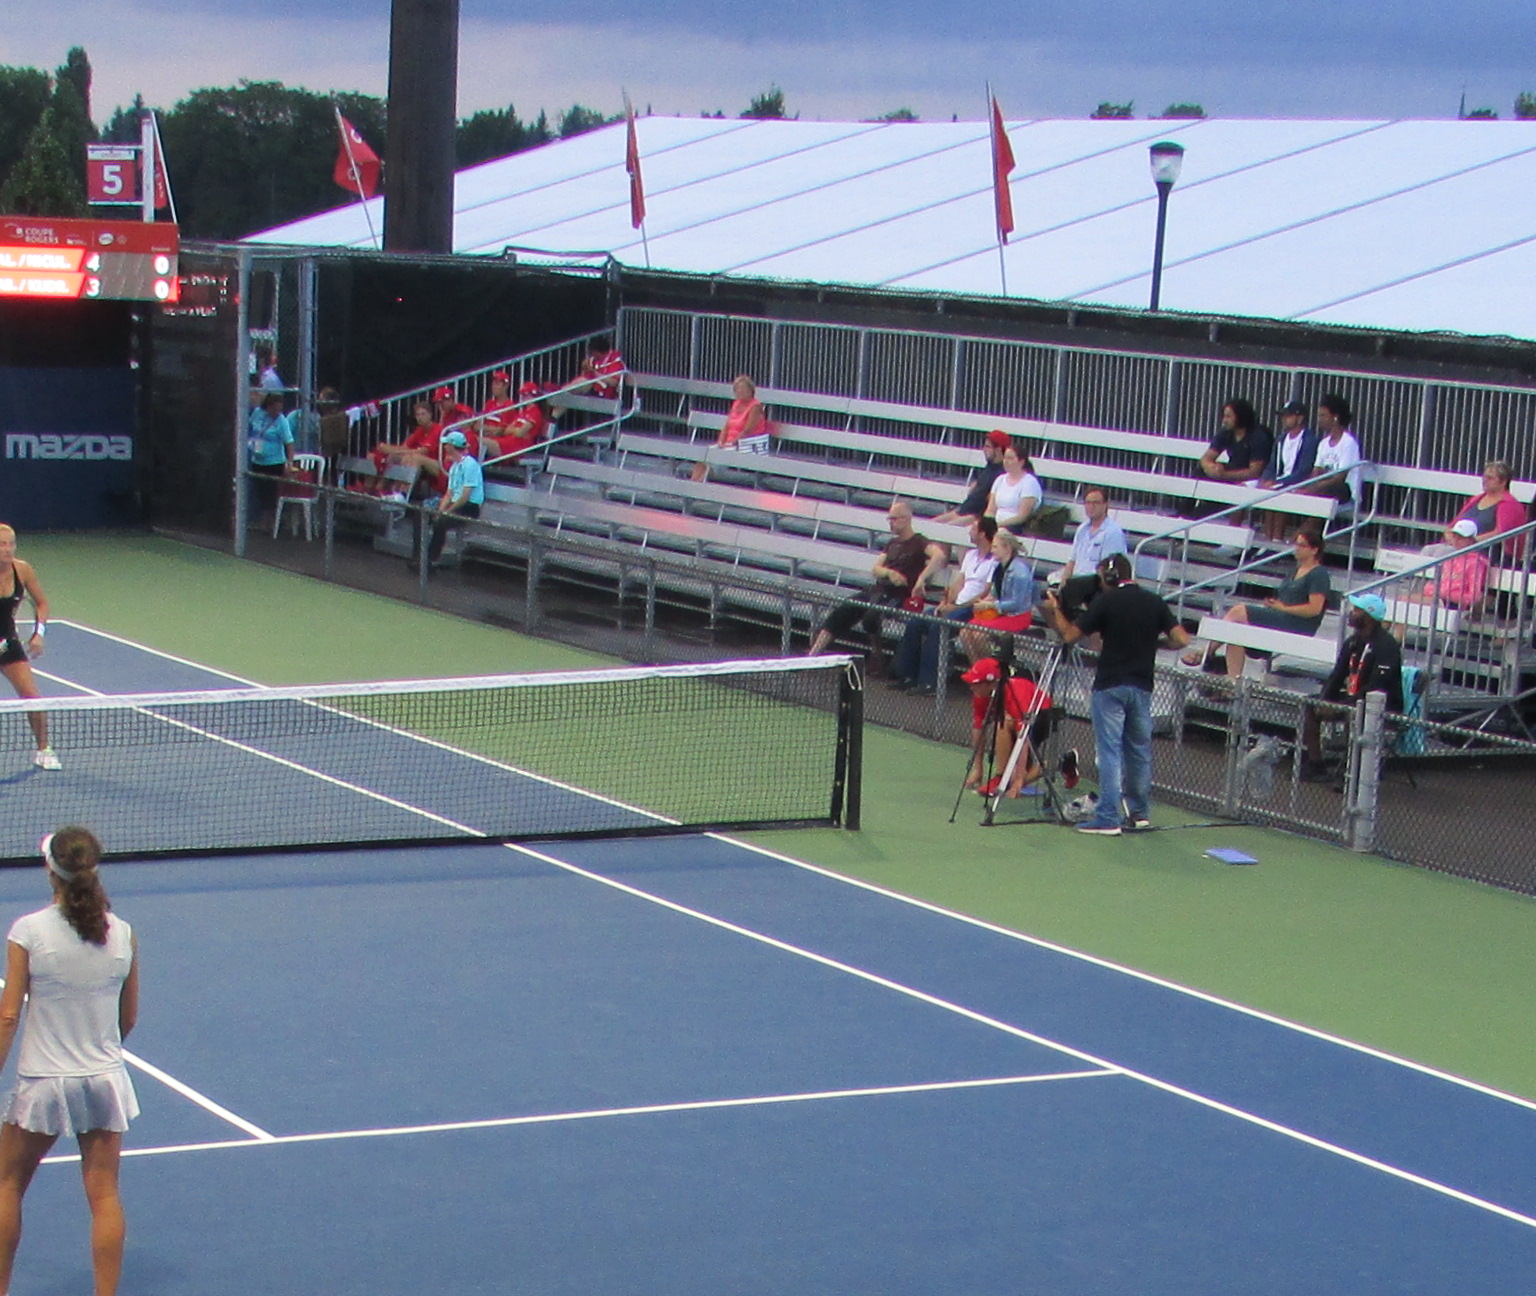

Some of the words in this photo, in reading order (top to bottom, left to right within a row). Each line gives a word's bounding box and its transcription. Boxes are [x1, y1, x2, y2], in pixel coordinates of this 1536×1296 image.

[102, 164, 124, 195] 5
[86, 253, 100, 272] 4
[154, 255, 170, 275] 0
[86, 278, 100, 297] 3
[154, 280, 170, 299] 0
